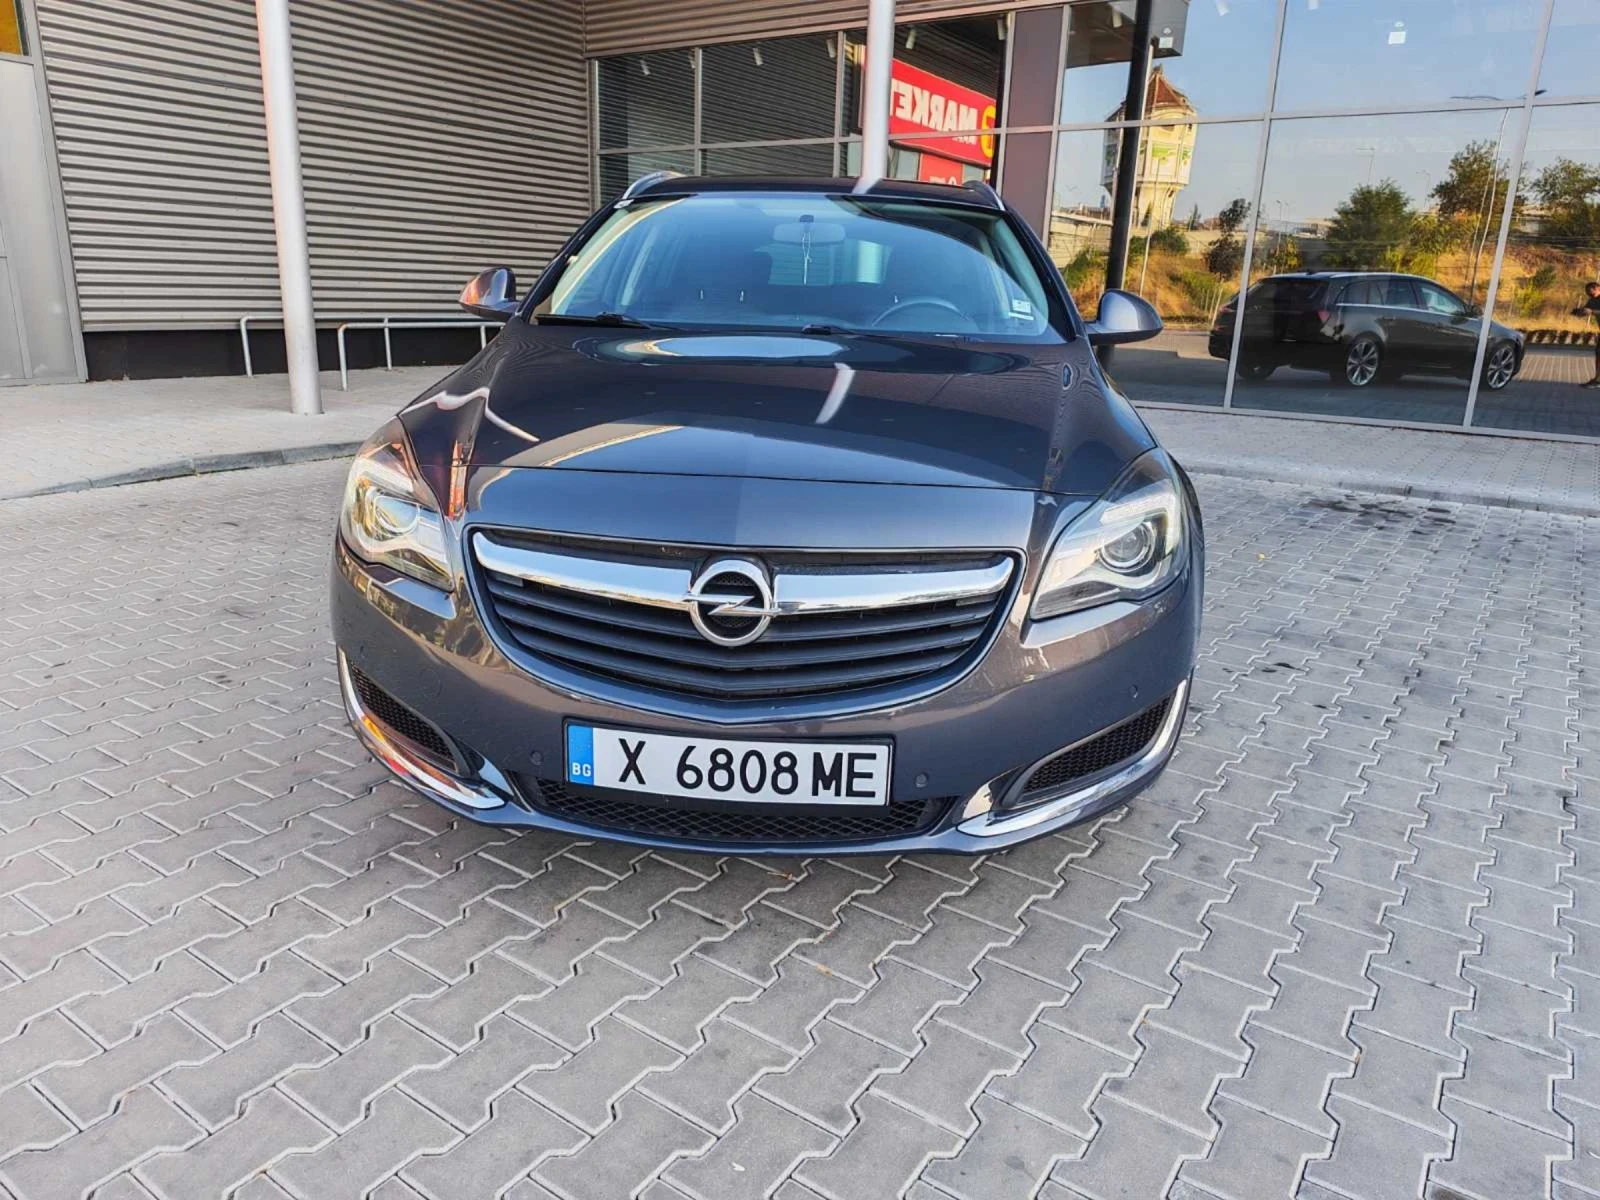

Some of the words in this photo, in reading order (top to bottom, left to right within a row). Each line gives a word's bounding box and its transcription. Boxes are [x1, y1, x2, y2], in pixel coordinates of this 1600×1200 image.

[572, 762, 592, 777] BG
[618, 738, 647, 785] X
[676, 745, 799, 796] 6808
[811, 752, 878, 798] ME
